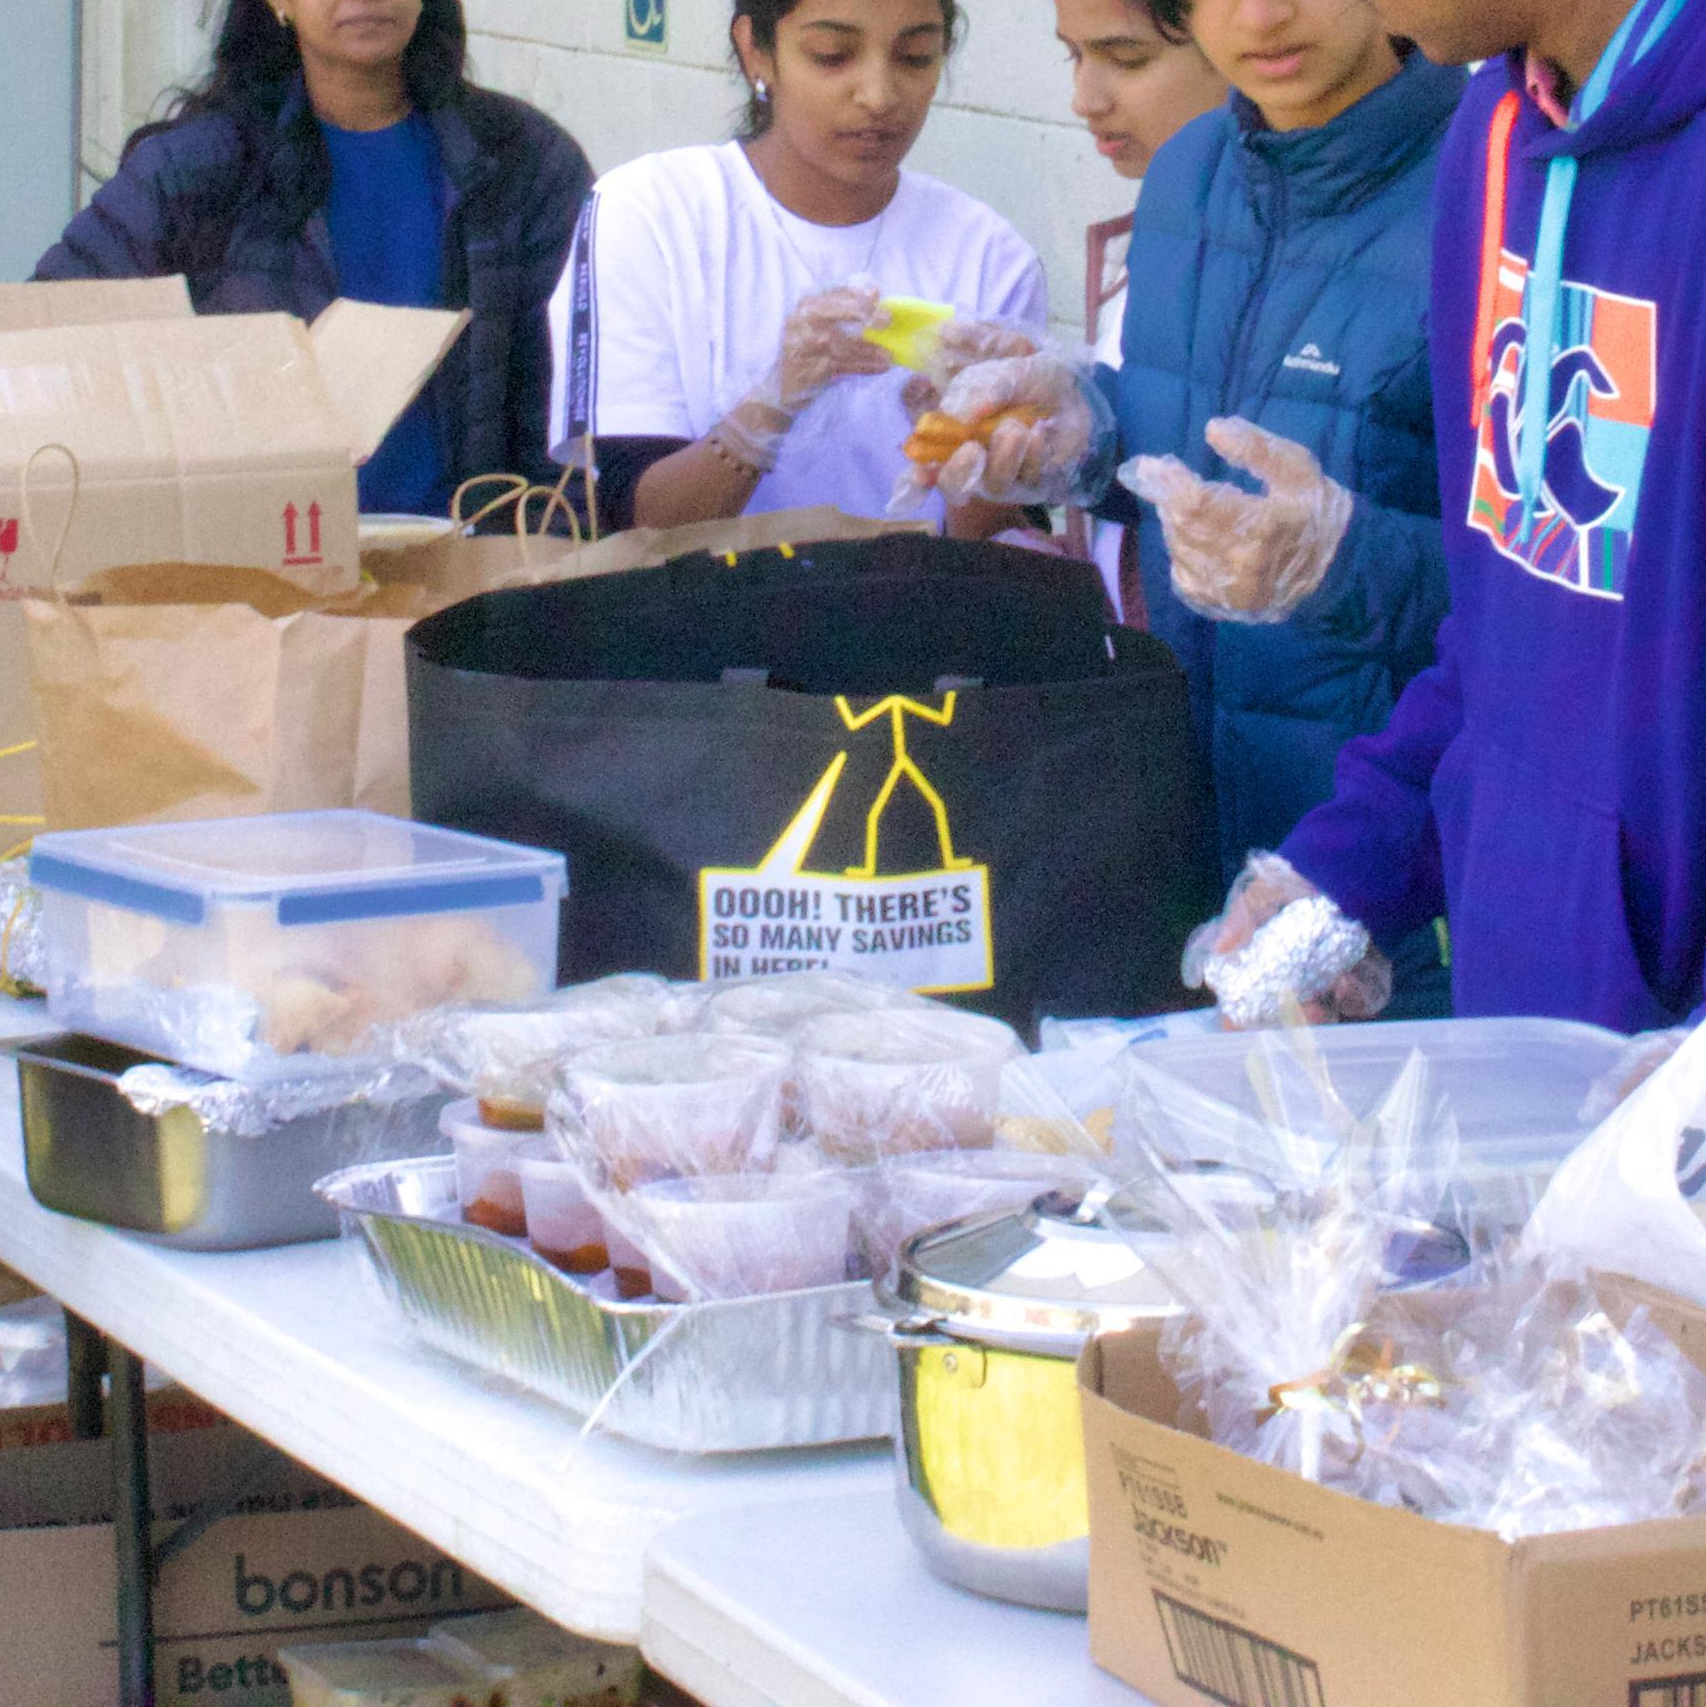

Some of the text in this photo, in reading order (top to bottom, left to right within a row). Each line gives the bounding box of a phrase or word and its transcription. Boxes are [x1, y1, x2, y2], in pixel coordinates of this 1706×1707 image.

[713, 884, 973, 924] OOOH! THERE'S
[712, 918, 973, 954] SO MANY SAVINGS
[712, 954, 741, 979] IN
[234, 1554, 464, 1618] bonson
